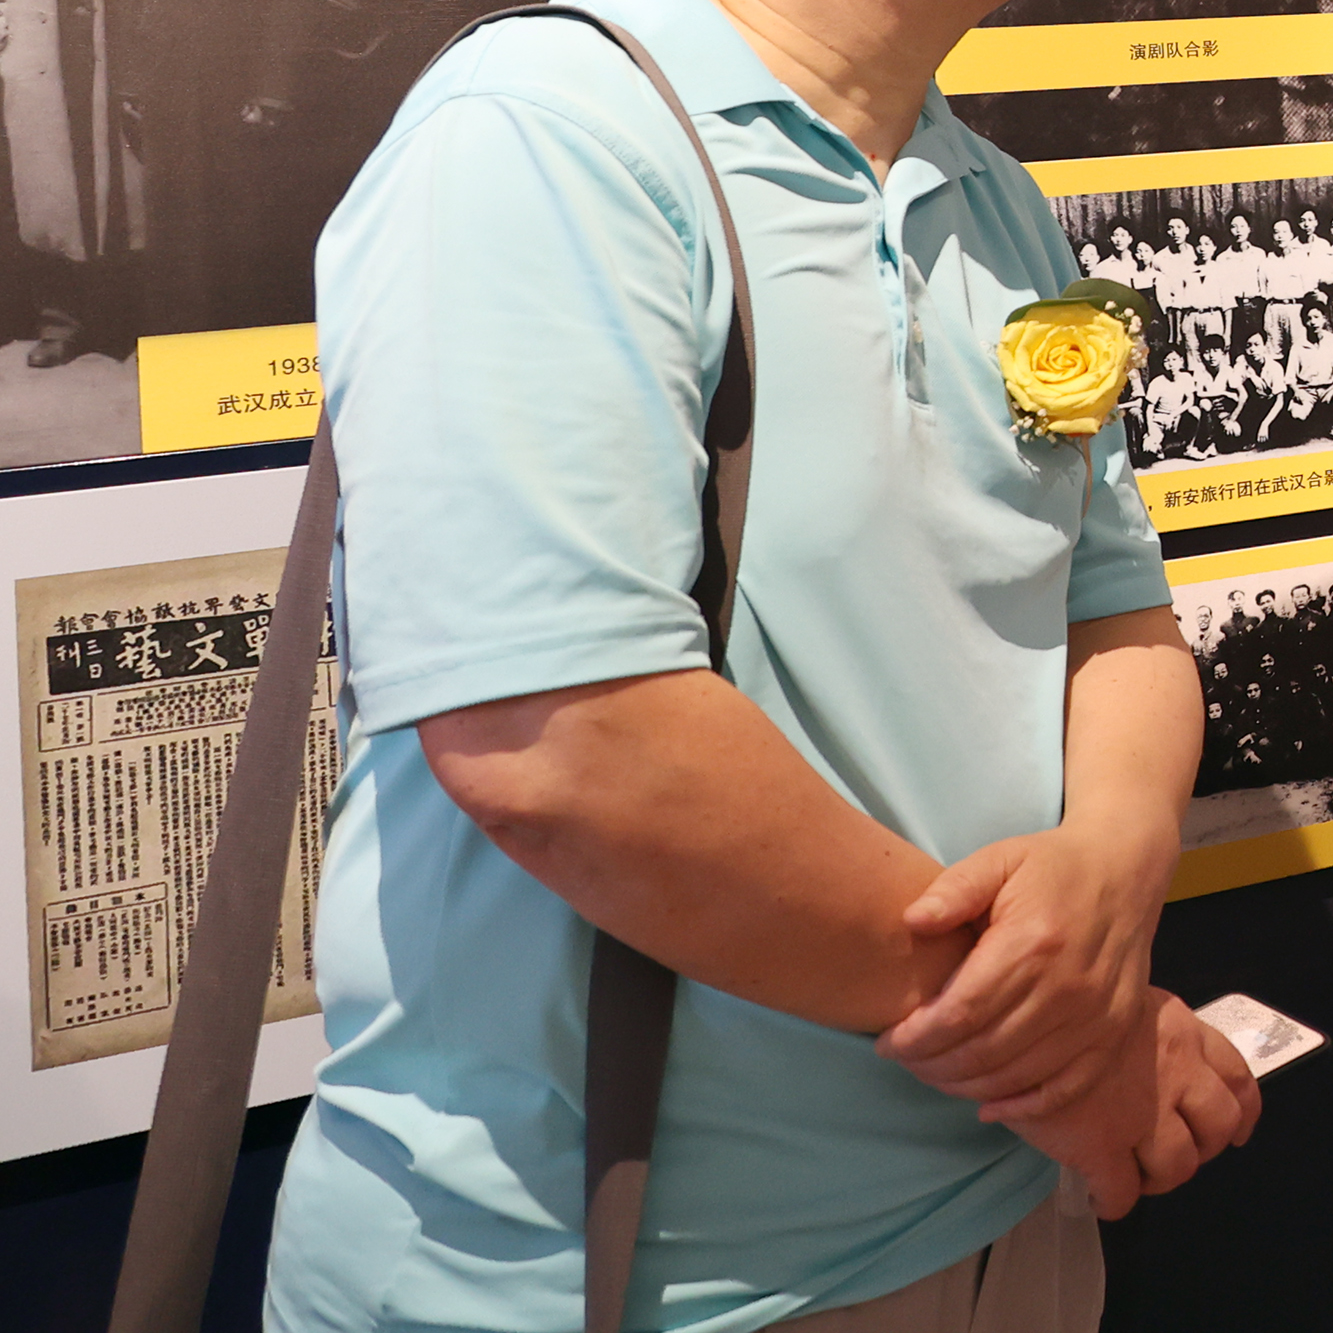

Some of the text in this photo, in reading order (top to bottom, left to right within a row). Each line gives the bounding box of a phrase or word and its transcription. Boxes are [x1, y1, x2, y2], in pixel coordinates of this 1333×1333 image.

[1129, 40, 1219, 60] 演剧队合影
[217, 388, 318, 416] 武汉成立
